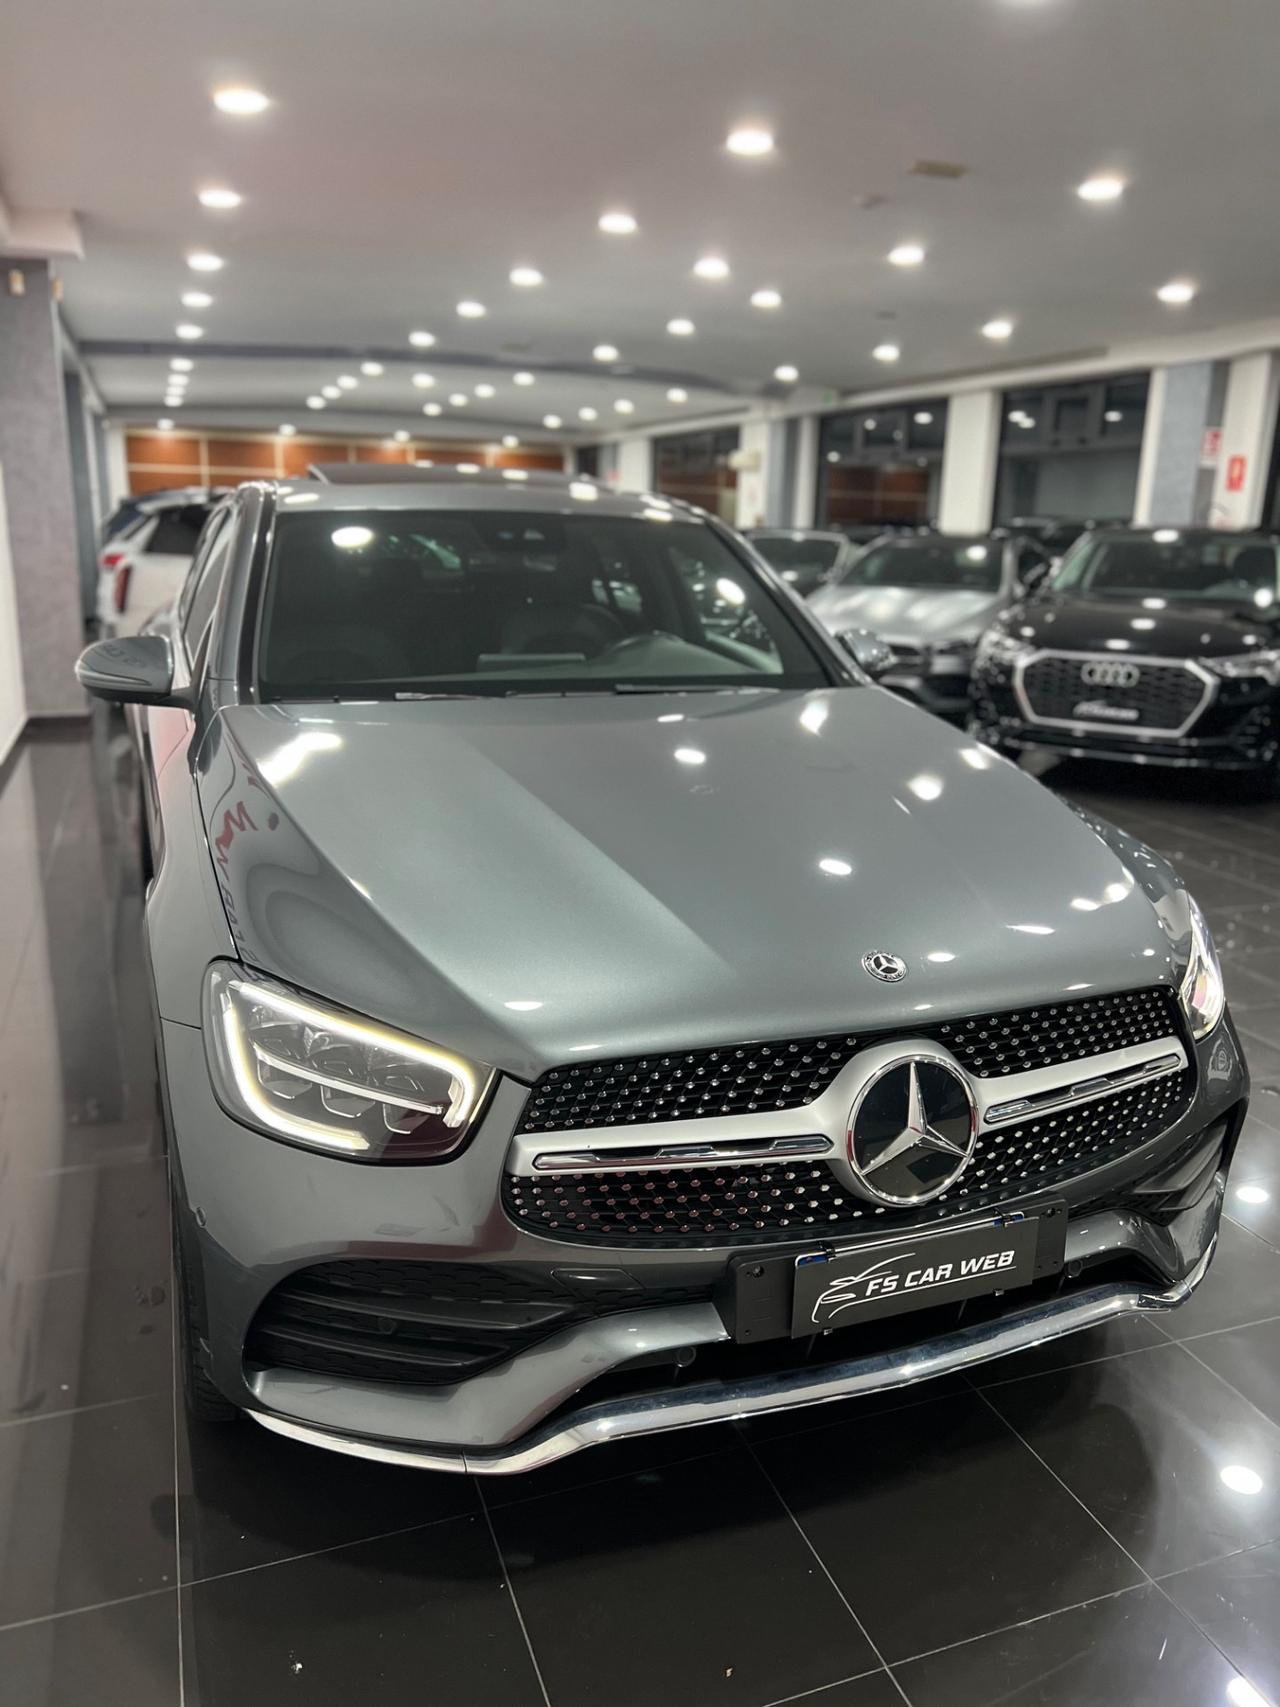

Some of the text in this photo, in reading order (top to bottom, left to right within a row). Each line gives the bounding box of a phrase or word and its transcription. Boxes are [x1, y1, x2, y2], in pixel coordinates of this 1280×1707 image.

[865, 1250, 1015, 1296] FS CAR WEB
